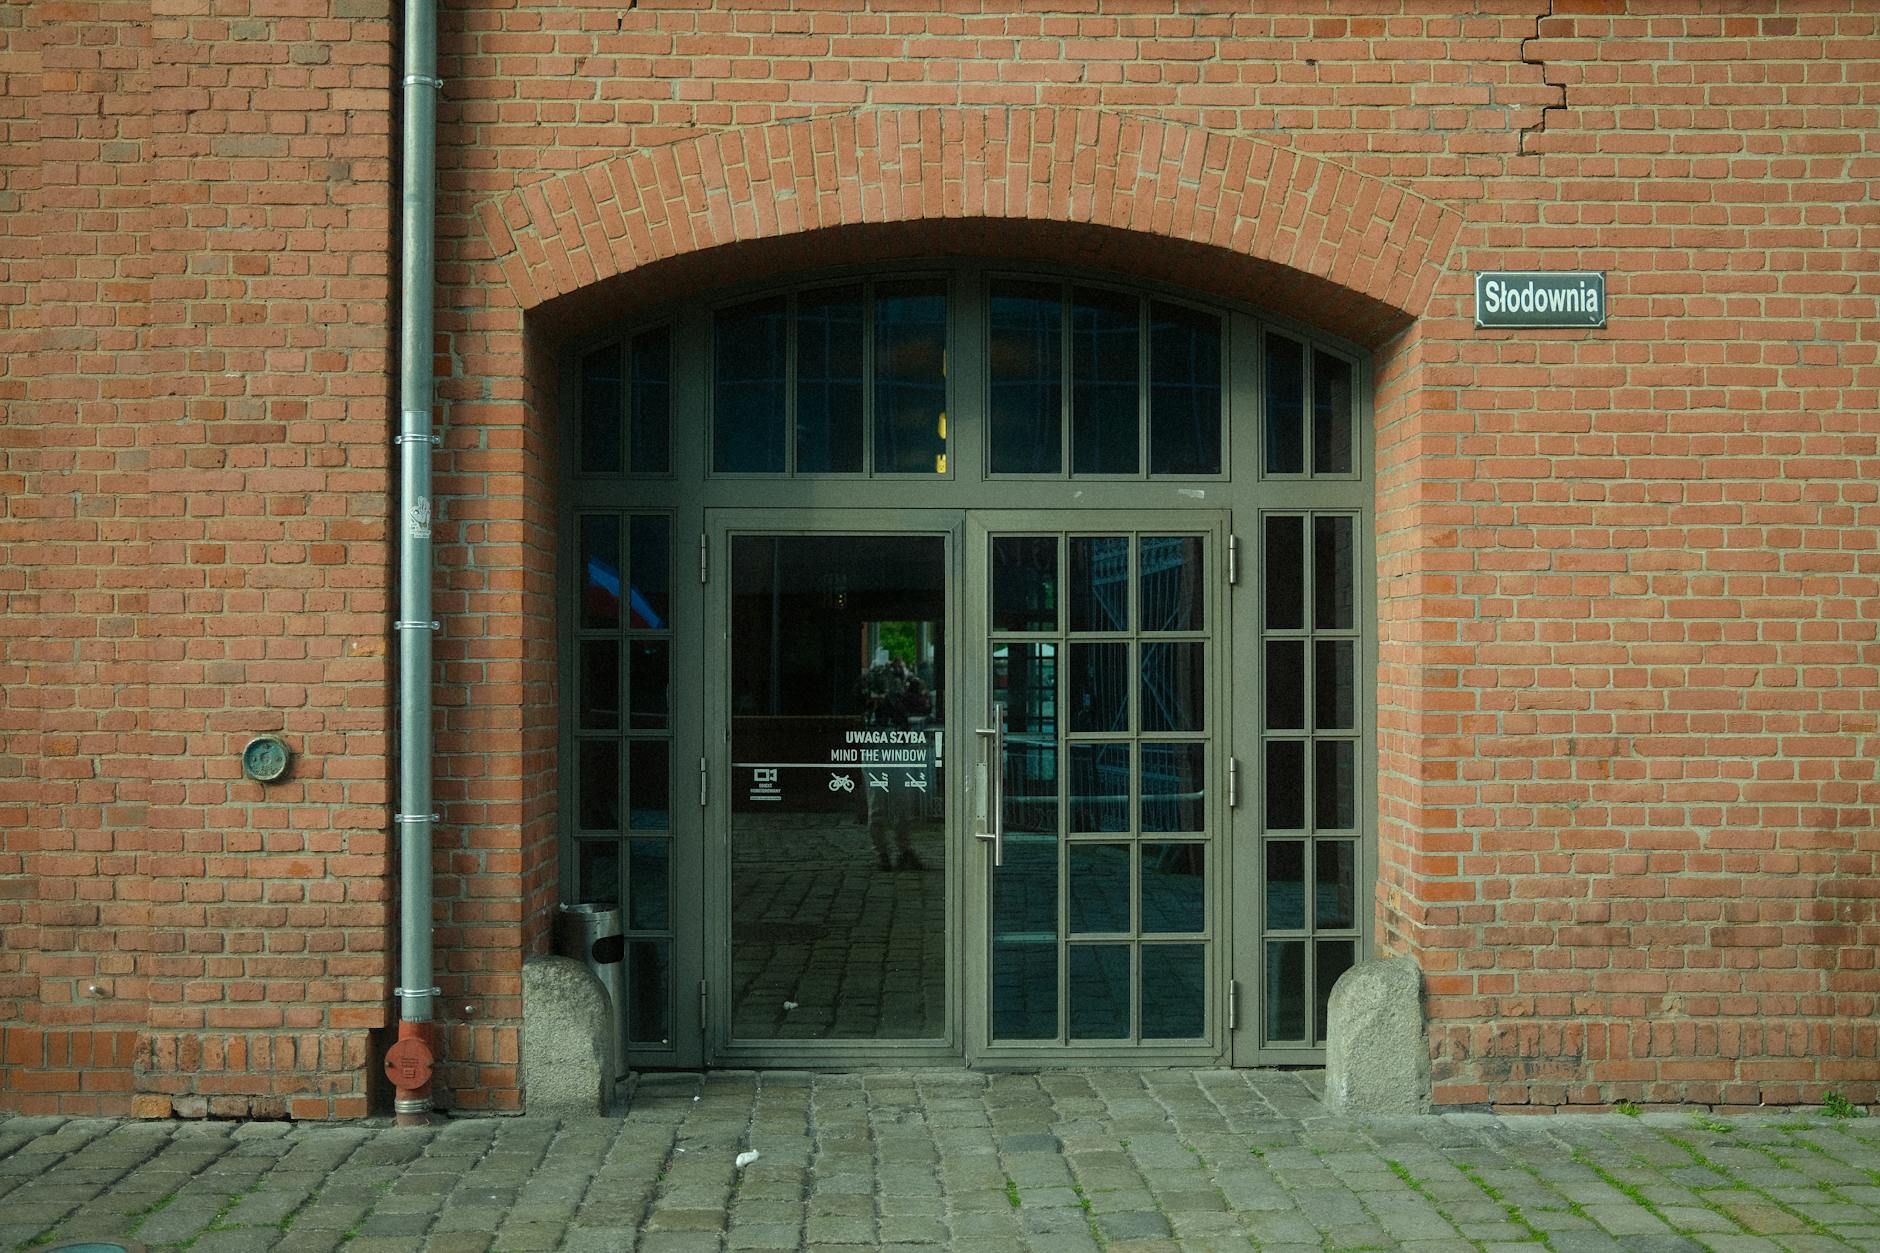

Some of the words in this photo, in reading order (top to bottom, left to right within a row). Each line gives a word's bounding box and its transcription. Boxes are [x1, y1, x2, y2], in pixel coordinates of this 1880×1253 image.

[1485, 281, 1598, 312] Słodownia
[845, 731, 888, 743] UWAGA
[889, 731, 926, 743] SZYBA
[831, 749, 858, 761] MIND
[860, 749, 879, 761] THE
[881, 749, 926, 761] WINDOW
